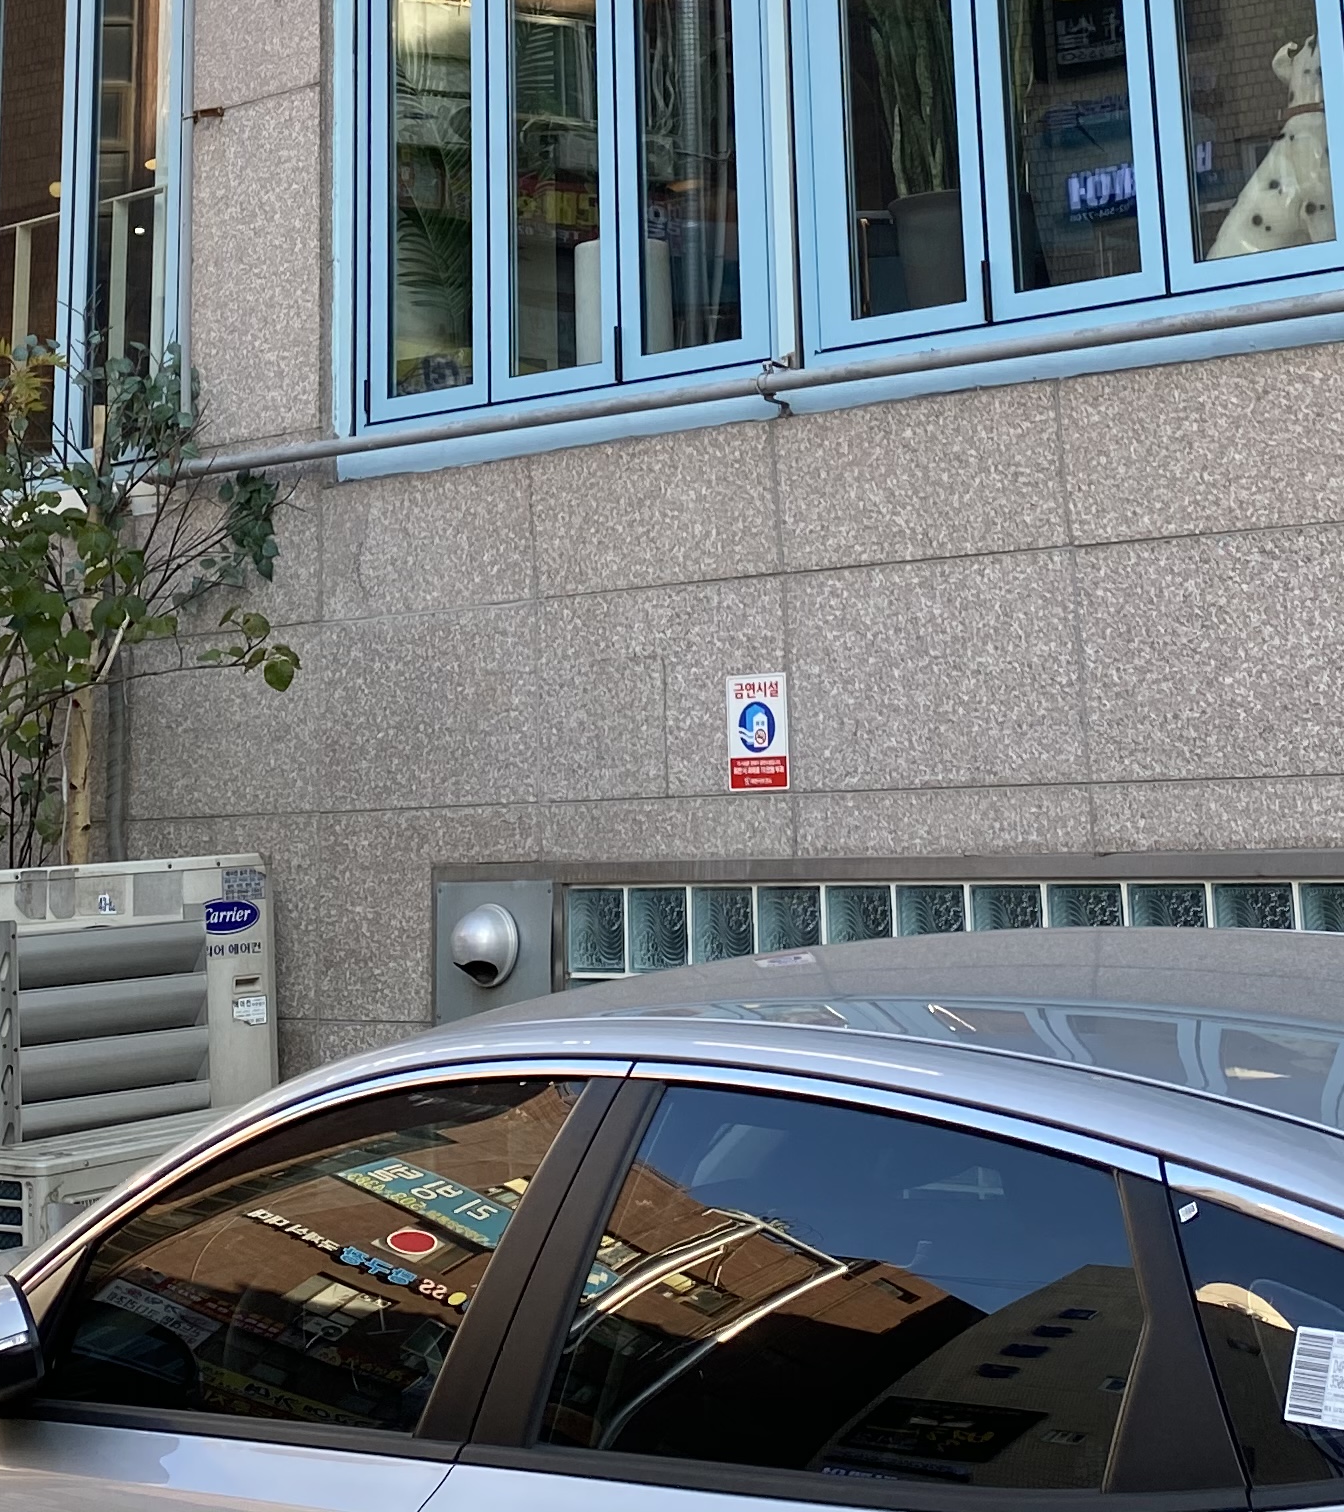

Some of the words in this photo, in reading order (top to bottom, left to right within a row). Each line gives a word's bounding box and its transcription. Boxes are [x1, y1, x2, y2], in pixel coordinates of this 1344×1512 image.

[733, 680, 779, 700] 금연시설
[204, 907, 252, 925] Carrier
[228, 941, 262, 956] 에어컨
